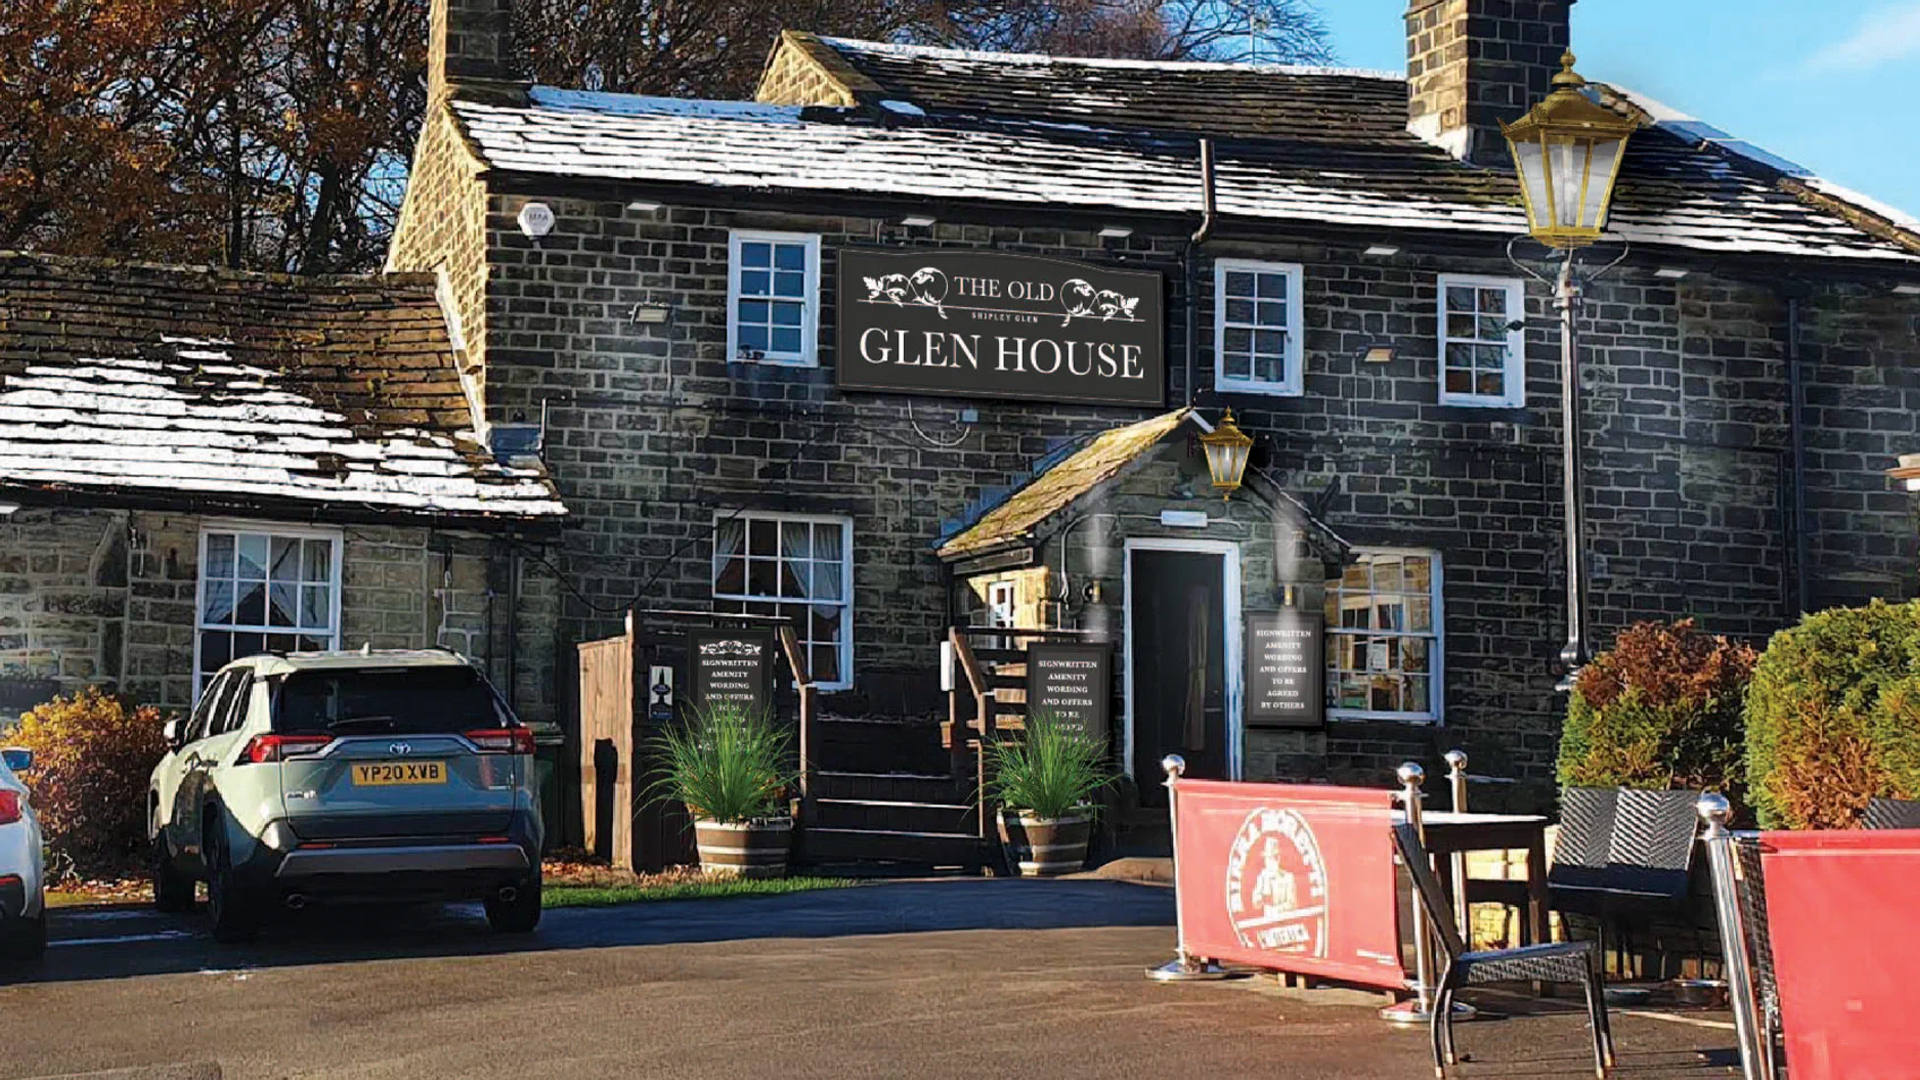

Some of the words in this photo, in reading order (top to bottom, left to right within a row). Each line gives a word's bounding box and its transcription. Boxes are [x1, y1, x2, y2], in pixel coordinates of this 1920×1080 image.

[954, 276, 1001, 298] THE
[1007, 281, 1055, 302] OLD
[971, 312, 1011, 322] SHIPLEY
[1014, 315, 1039, 323] GLEN
[859, 327, 982, 370] GLEN
[994, 336, 1144, 379] HOUSE
[1047, 685, 1088, 693] WORDING
[359, 765, 403, 781] YP20
[408, 763, 439, 780] XVB
